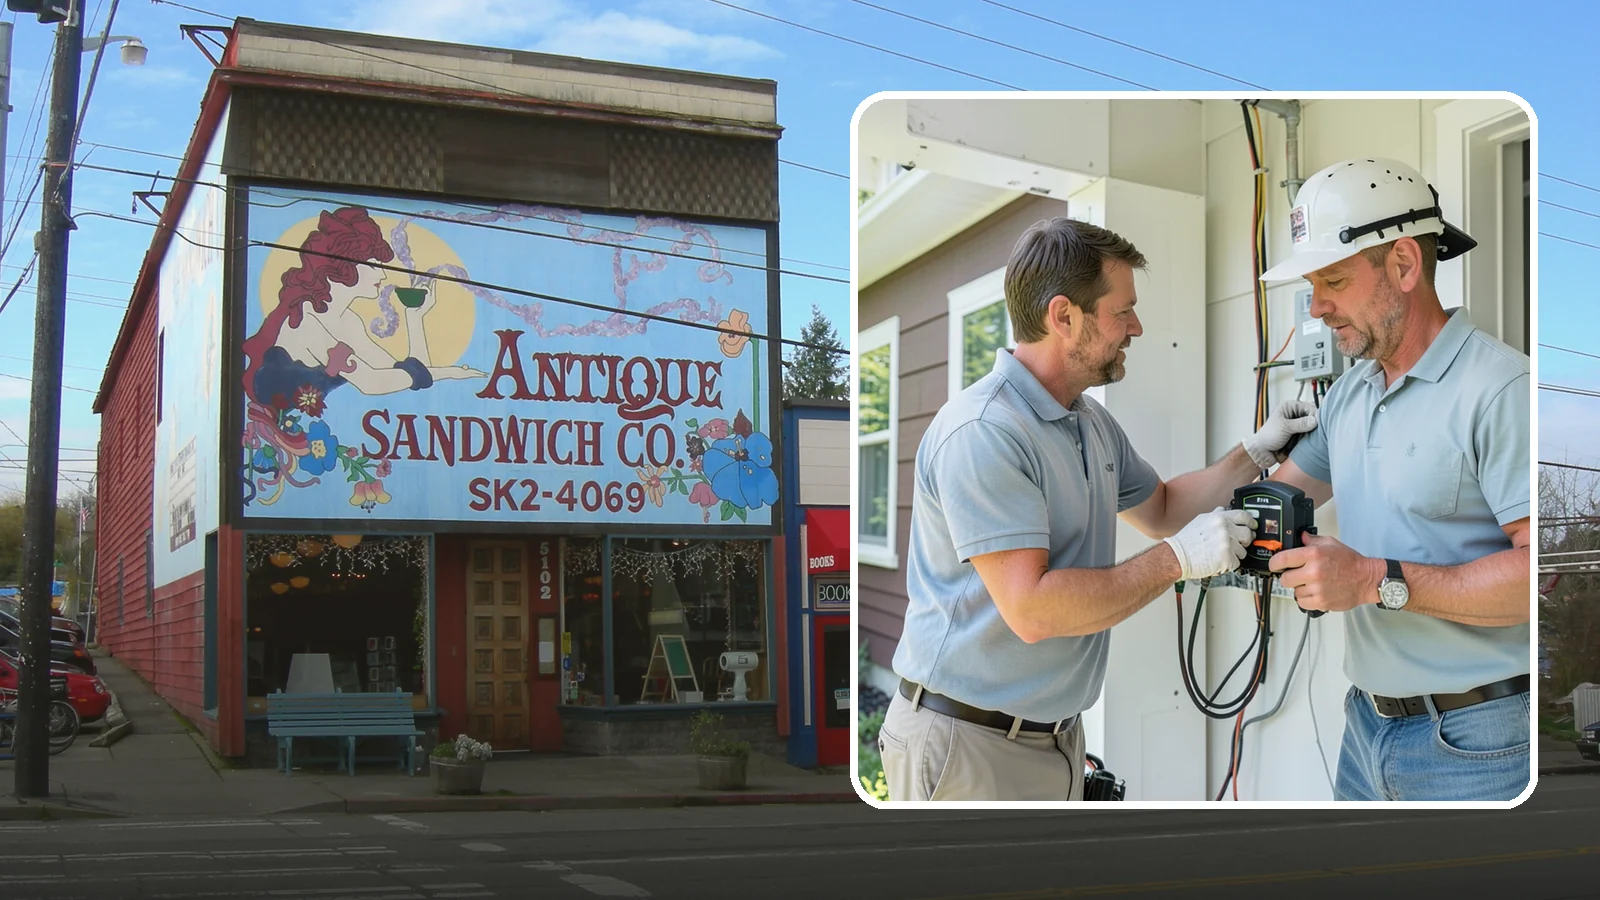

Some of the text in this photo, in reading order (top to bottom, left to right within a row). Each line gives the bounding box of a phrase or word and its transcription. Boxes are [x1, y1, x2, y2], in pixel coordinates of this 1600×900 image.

[477, 329, 723, 420] ANTIQUE
[361, 409, 684, 468] SANDWICH CO.
[468, 478, 646, 513] SK2-4069
[540, 541, 551, 600] 5102
[809, 555, 835, 569] BOOKS
